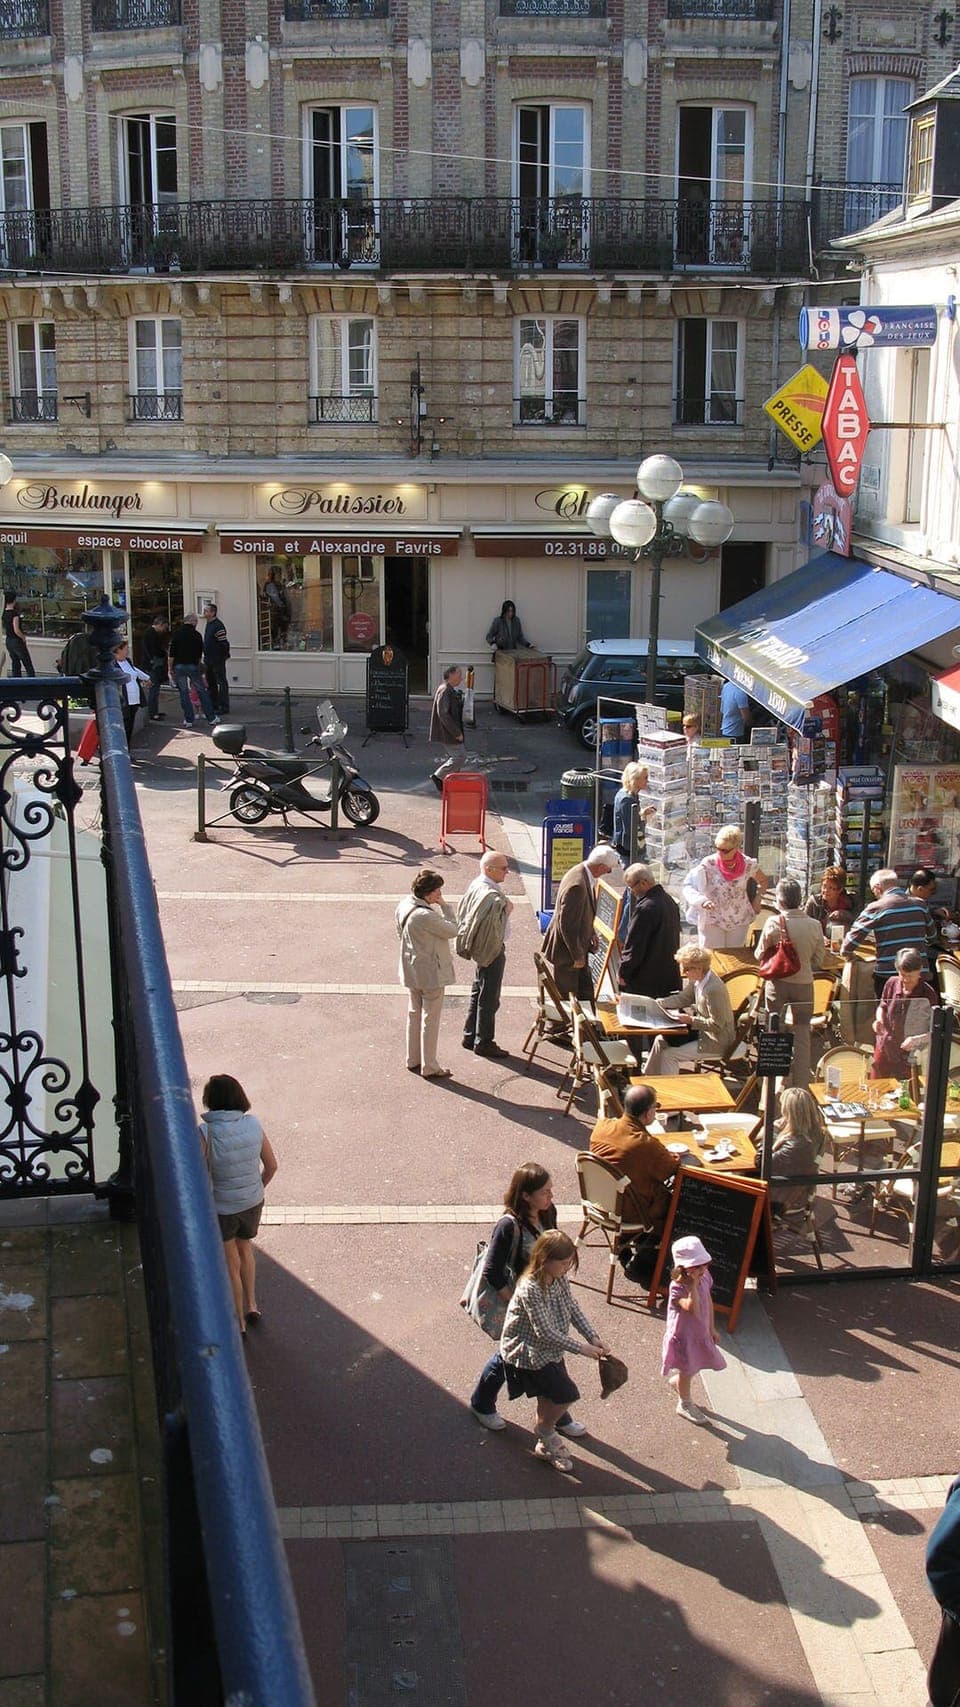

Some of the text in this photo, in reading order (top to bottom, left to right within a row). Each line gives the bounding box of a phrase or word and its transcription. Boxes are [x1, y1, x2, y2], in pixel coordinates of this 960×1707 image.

[817, 310, 831, 349] LOTO
[907, 331, 930, 339] JEUX
[772, 399, 813, 446] PRESSE
[837, 366, 861, 485] TABAC
[17, 482, 143, 518] Boulanger
[78, 536, 184, 551] espace chocolat
[233, 539, 442, 555] Sonia et Alexandre Favris
